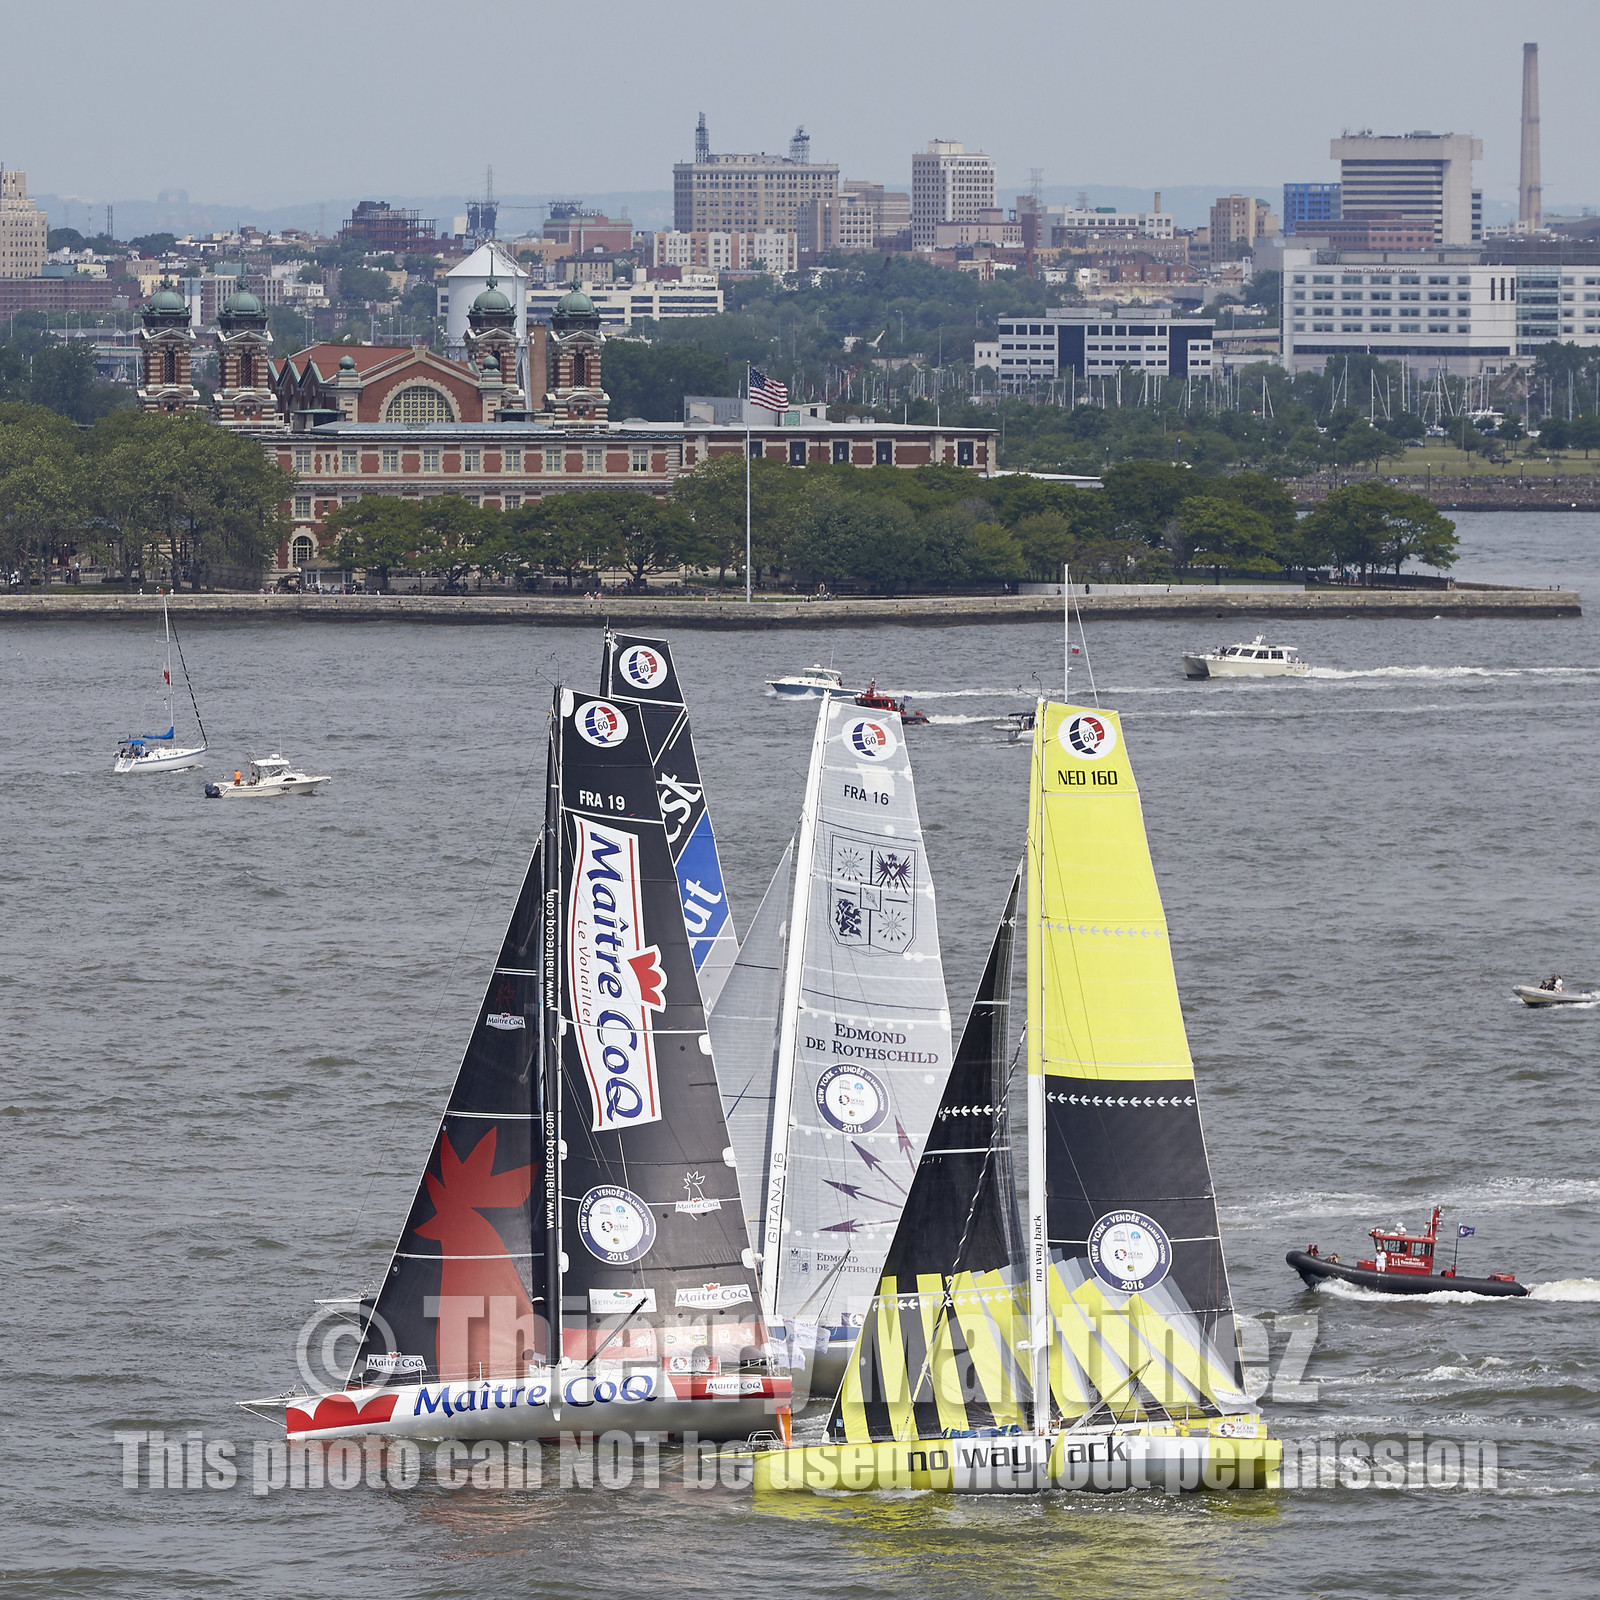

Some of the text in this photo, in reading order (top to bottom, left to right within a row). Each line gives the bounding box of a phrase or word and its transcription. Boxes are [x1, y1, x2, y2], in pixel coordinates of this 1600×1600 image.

[639, 664, 649, 674] 60
[597, 720, 609, 731] 60
[865, 736, 876, 746] 60
[1083, 731, 1095, 743] 60
[1058, 770, 1118, 785] NED 160
[579, 789, 626, 811] FRA 19
[844, 784, 889, 805] FRA 16
[545, 890, 557, 1009] www.maitrecoq.com
[586, 830, 643, 1122] Maître CoQ
[834, 1022, 907, 1045] EDMOND
[805, 1036, 939, 1064] DE ROTHSCHILD
[819, 1070, 835, 1090] YORK
[838, 1065, 866, 1077] VENDÉE
[818, 1088, 826, 1104] NEW
[842, 1123, 864, 1133] 2016
[545, 1111, 556, 1230] www.maitrecoq.com
[596, 1188, 625, 1198] VENDÉE
[767, 1152, 784, 1244] GITANA 16
[582, 1196, 595, 1214] YORK
[581, 1216, 589, 1233] NEW
[1109, 1213, 1141, 1224] VENDÉE
[1092, 1222, 1107, 1243] YORK
[606, 1251, 629, 1261] 2016
[1033, 1214, 1043, 1282] no way back
[1091, 1244, 1100, 1263] NEW
[817, 1263, 829, 1271] DE
[1121, 1280, 1145, 1290] 2016
[414, 1374, 658, 1418] Maître CoQ
[908, 1450, 949, 1472] no
[962, 1445, 1031, 1474] way
